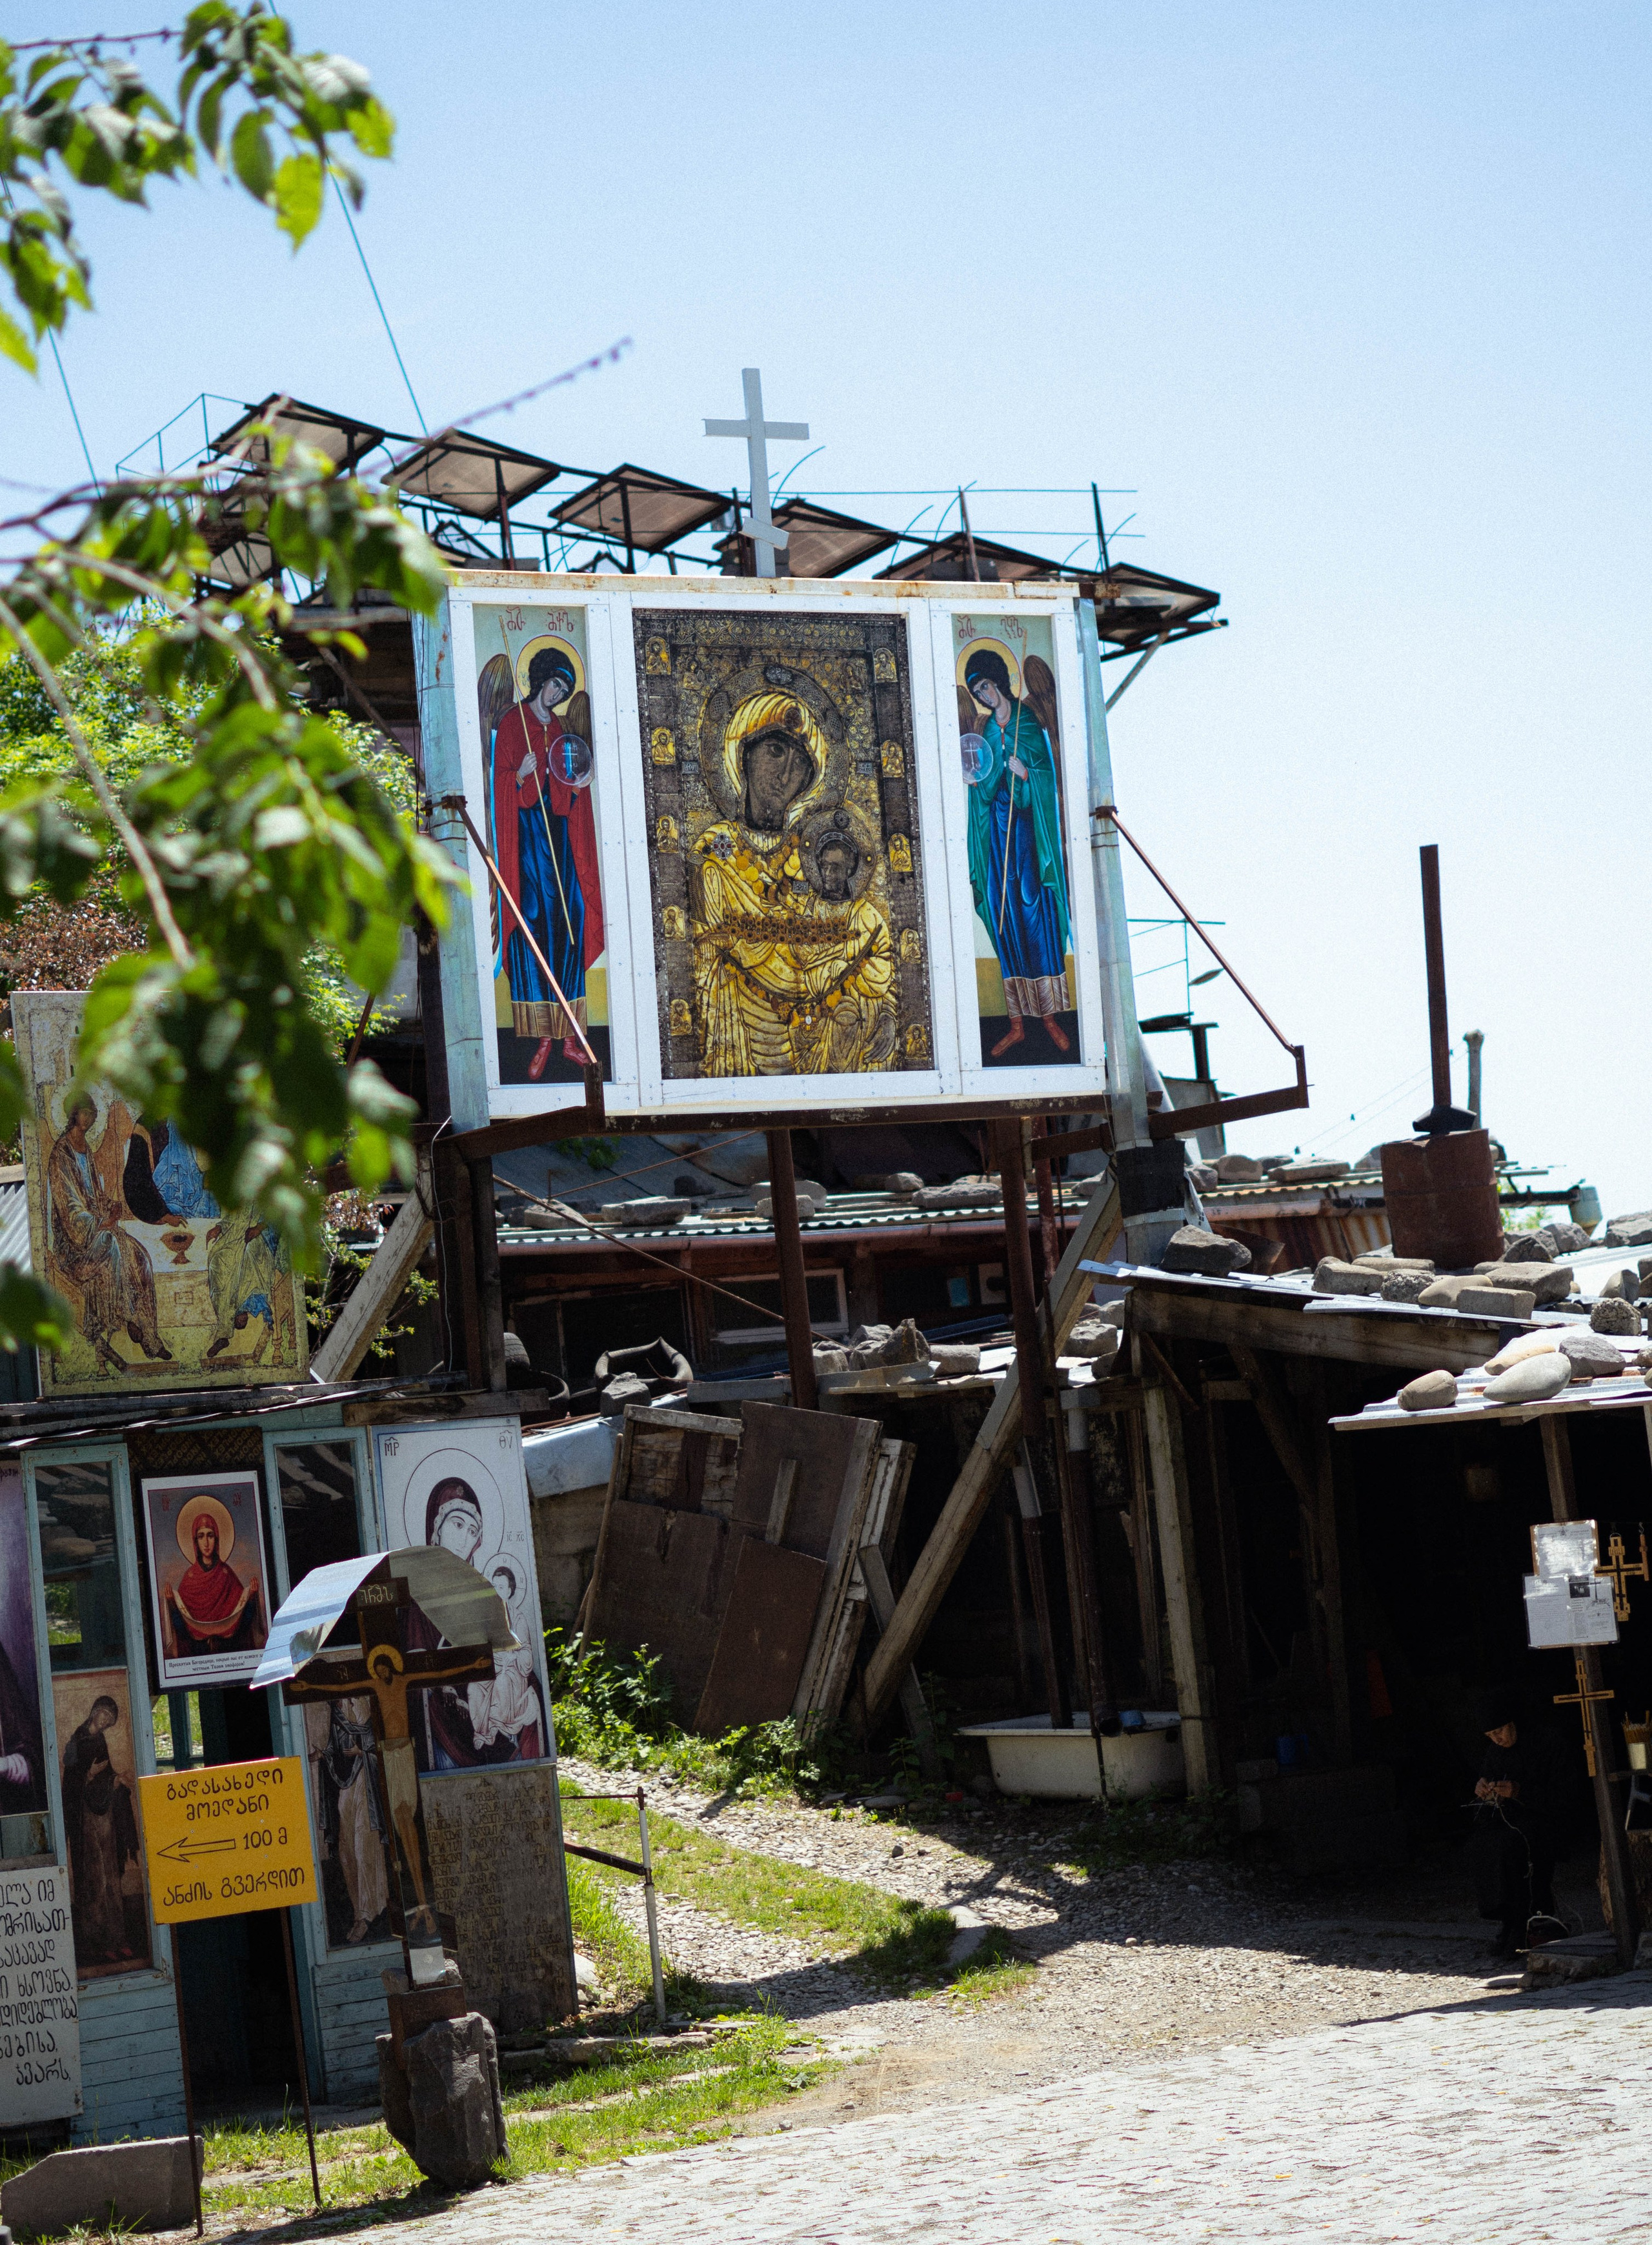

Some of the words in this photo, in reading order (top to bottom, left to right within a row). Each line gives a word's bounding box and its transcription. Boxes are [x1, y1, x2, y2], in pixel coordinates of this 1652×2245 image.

[166, 1768, 283, 1800] გადასახედი
[186, 1794, 269, 1821] მოედანი
[243, 1829, 272, 1850] 100
[278, 1827, 288, 1845] მ
[38, 1878, 54, 1902] იმ
[163, 1880, 212, 1906] ანძის
[221, 1867, 305, 1898] გვერდით
[17, 1967, 73, 1997] ხსოვნა.
